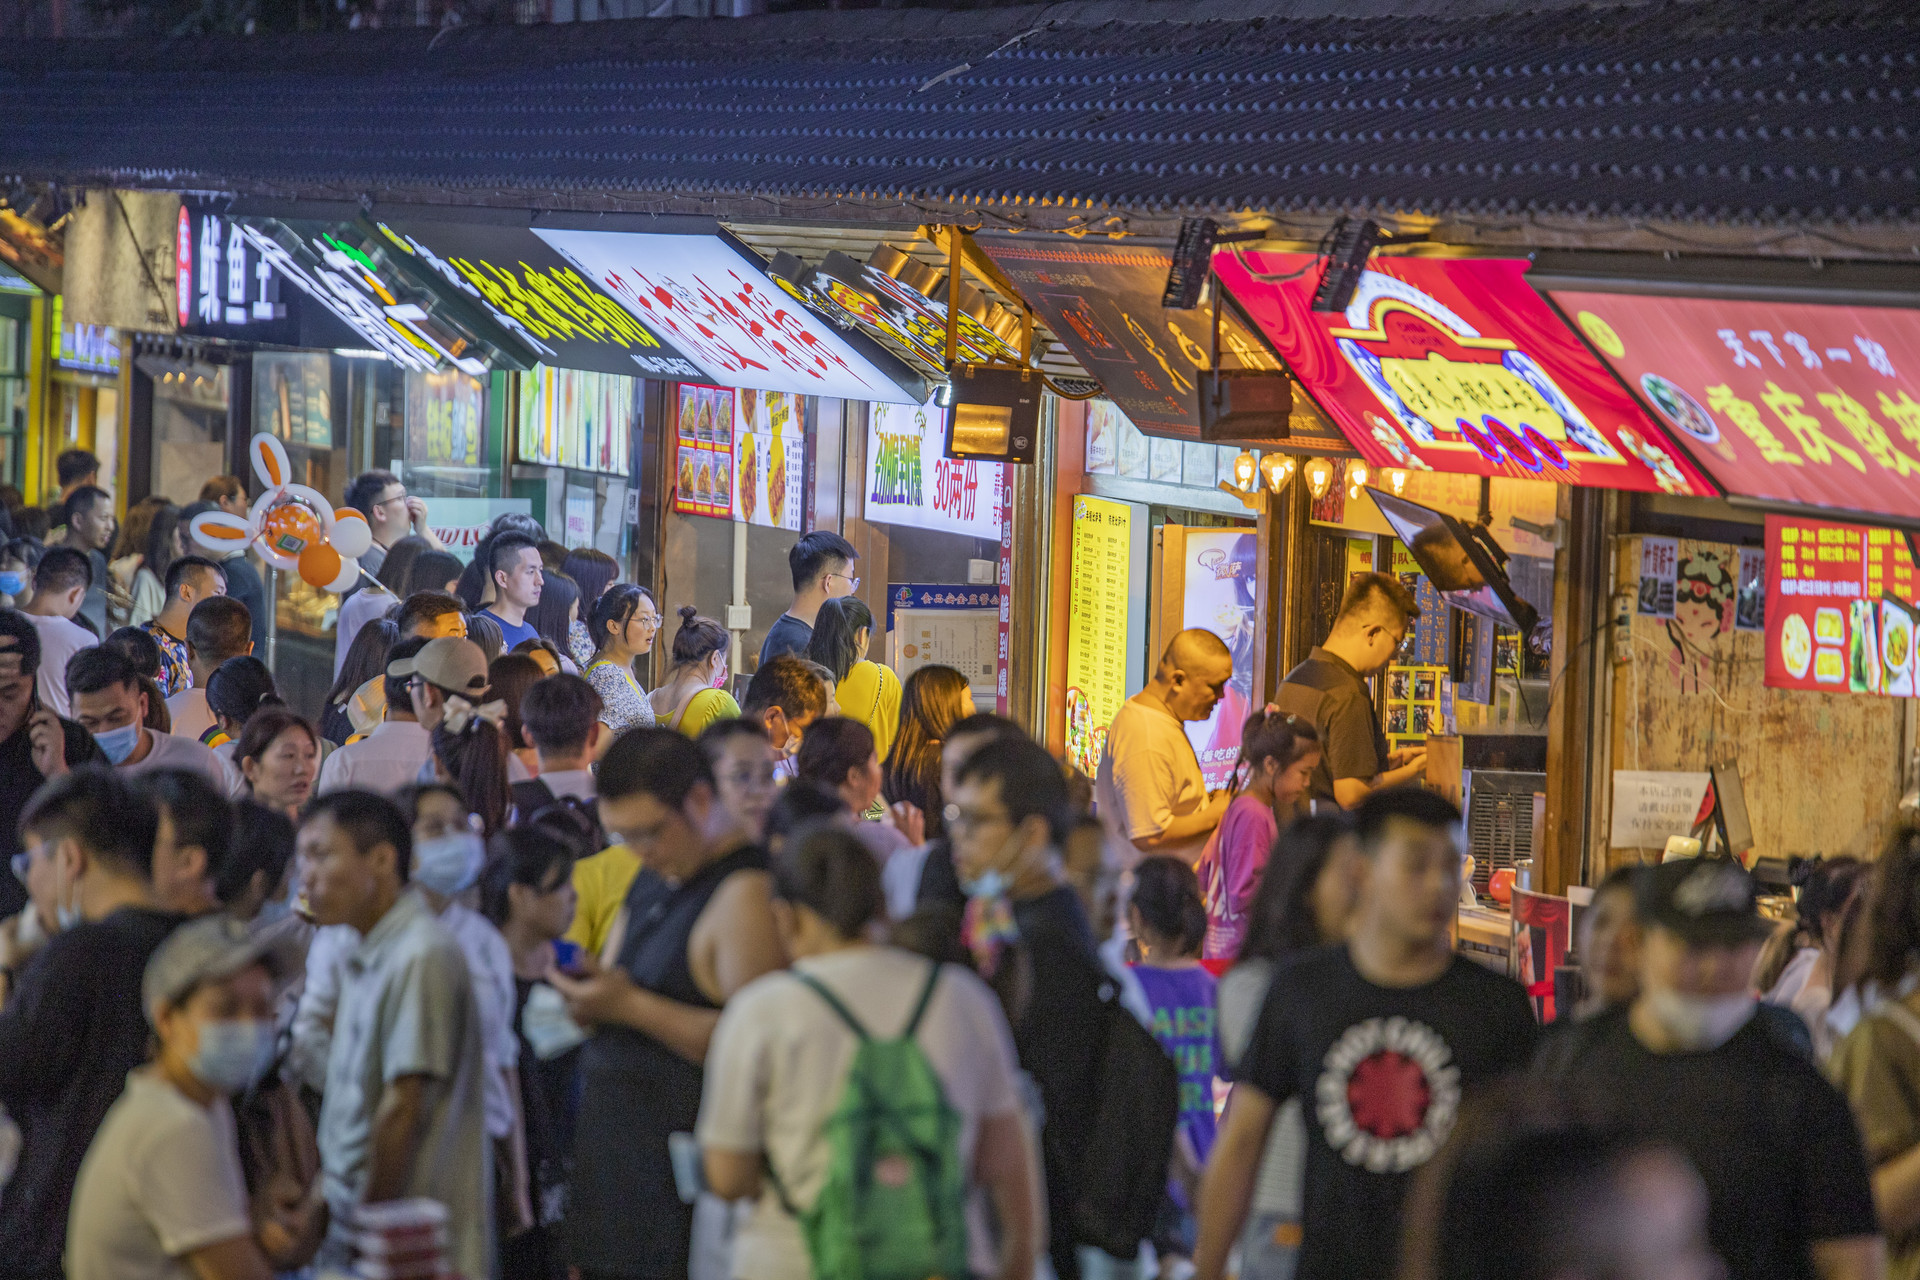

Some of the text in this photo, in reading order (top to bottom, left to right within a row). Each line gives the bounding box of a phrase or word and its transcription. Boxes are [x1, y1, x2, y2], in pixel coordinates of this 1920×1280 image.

[448, 257, 661, 349] 铁板鸭肠
[605, 267, 876, 392] 脆皮猪蹄
